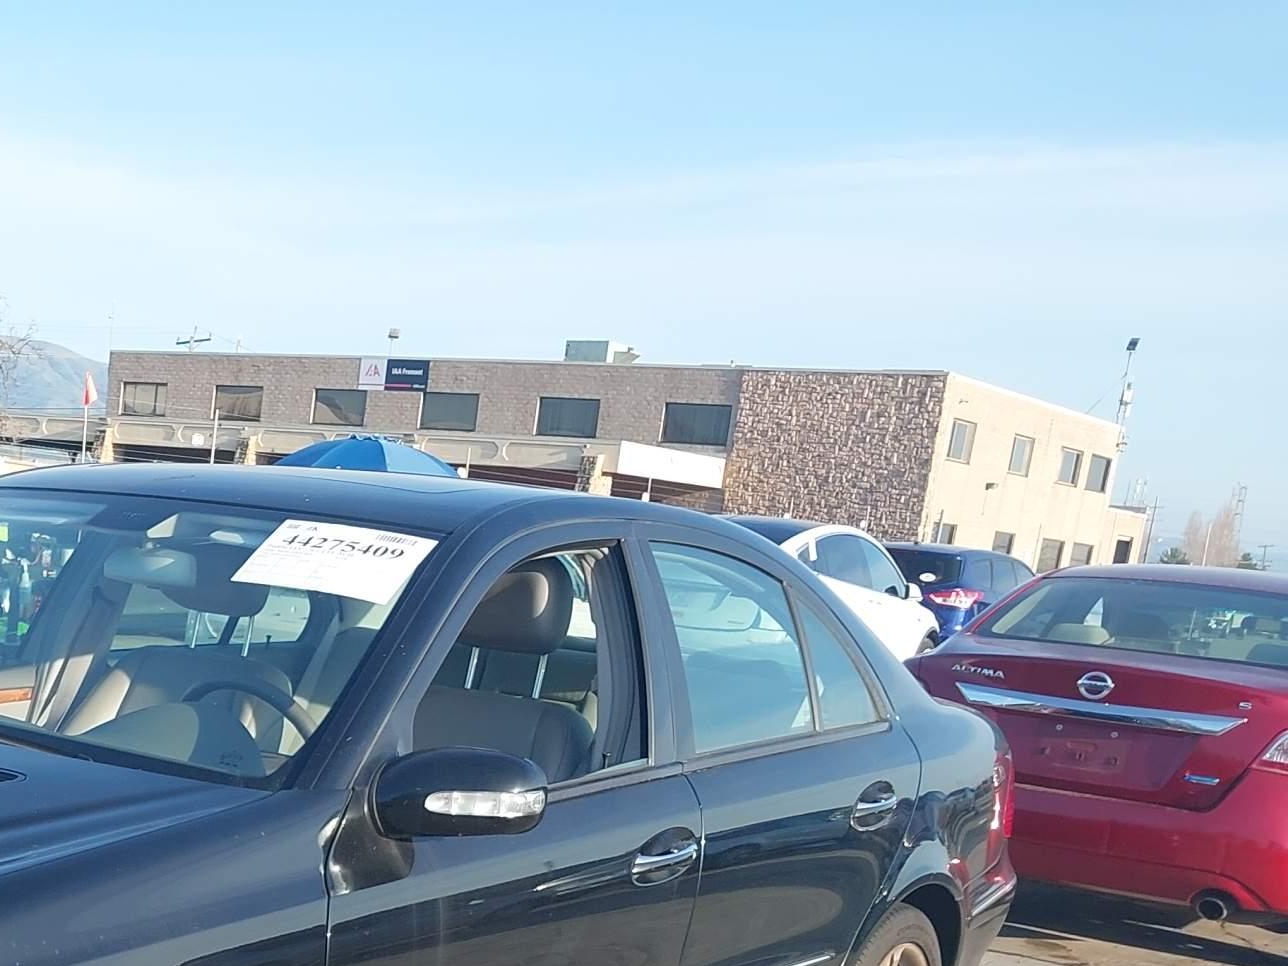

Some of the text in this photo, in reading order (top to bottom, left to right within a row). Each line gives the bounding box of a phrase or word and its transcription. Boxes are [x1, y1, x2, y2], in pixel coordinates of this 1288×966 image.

[282, 533, 406, 560] 44275409
[951, 664, 1005, 679] ALTIMA
[1238, 701, 1253, 710] S
